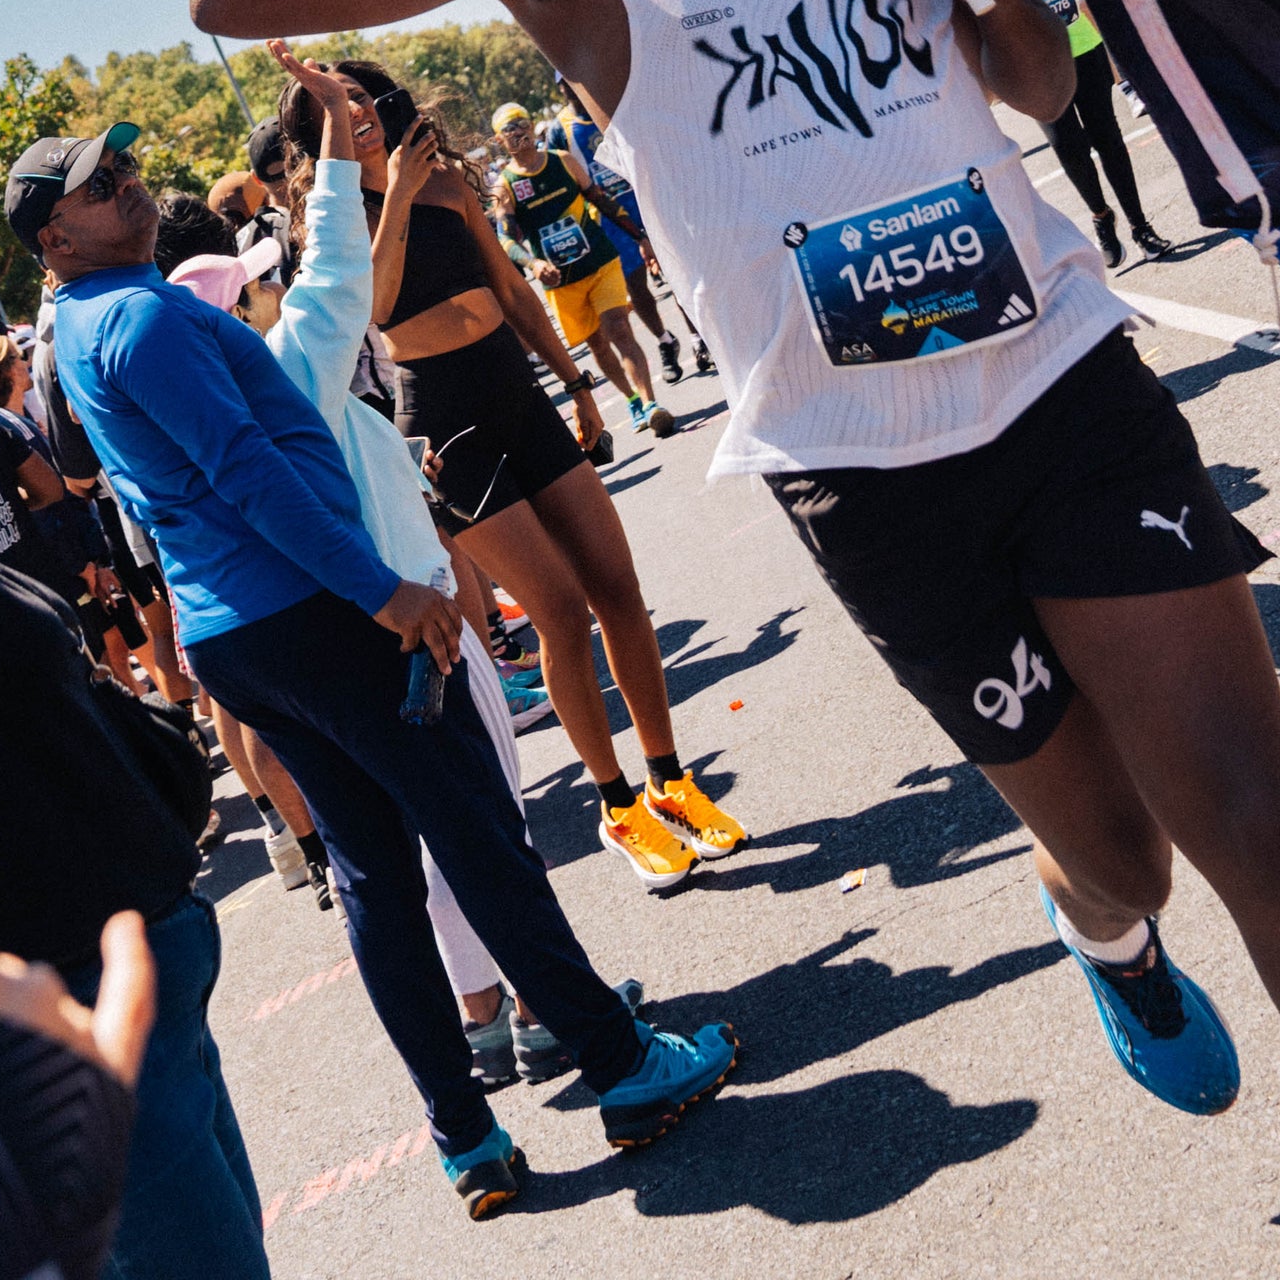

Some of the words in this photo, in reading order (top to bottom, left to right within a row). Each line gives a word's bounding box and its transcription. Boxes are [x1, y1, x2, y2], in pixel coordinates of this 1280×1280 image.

[743, 138, 777, 157] CAPE
[779, 125, 823, 147] TOWN
[875, 91, 941, 119] MARATHON
[868, 197, 961, 241] Sanlam
[839, 225, 984, 302] 14549
[910, 302, 940, 318] CAPE
[941, 290, 975, 307] TOWN
[913, 301, 979, 328] MARATHON
[842, 342, 874, 356] ASA
[973, 636, 1053, 730] 94
